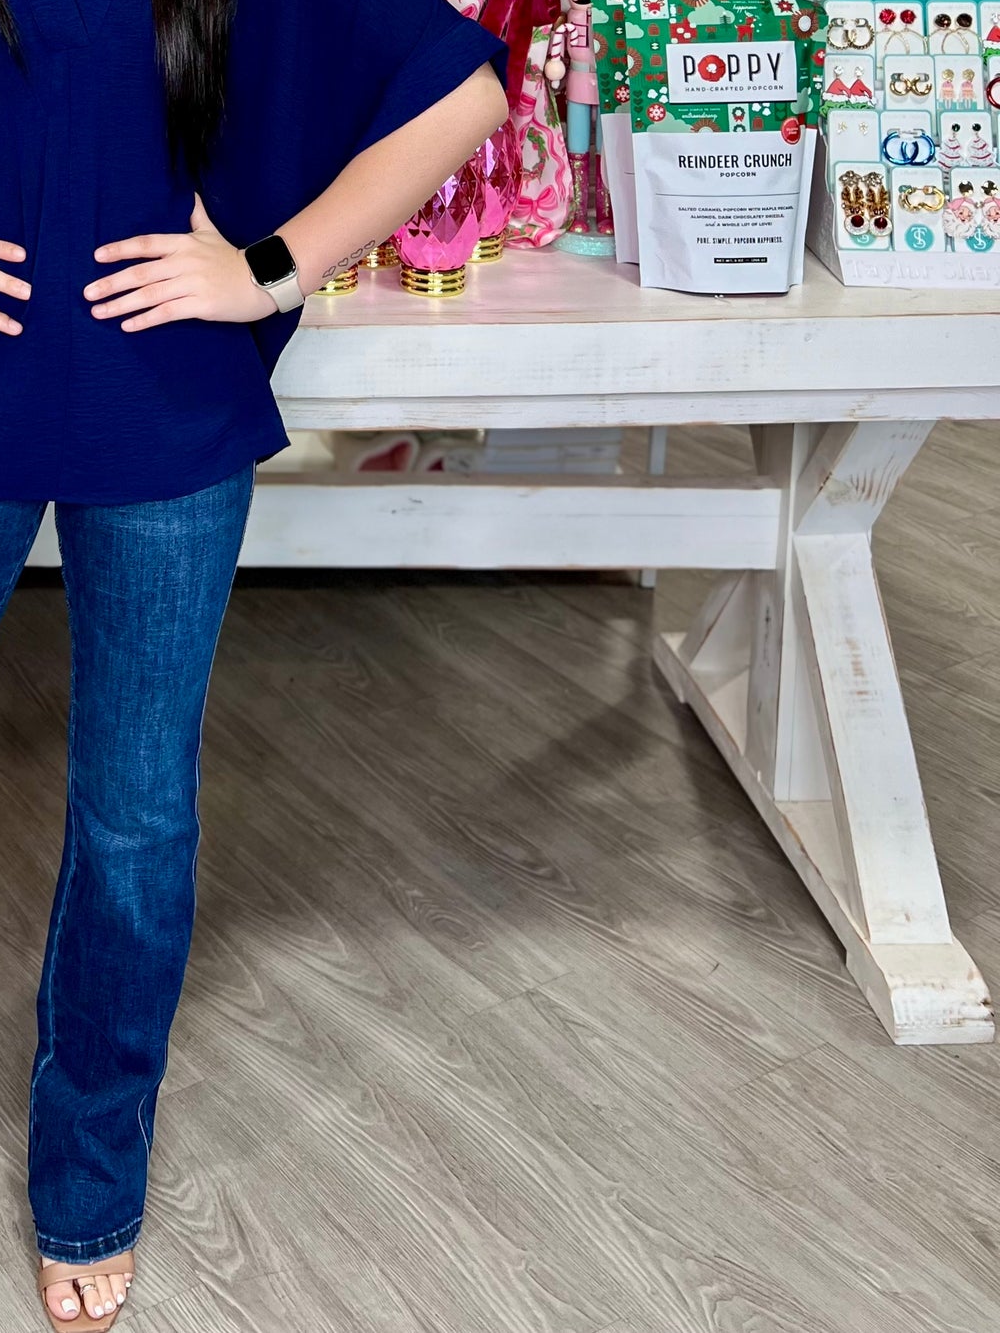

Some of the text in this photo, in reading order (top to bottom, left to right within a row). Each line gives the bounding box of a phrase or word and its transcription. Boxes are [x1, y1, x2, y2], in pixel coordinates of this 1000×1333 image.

[682, 52, 781, 83] POPPY
[678, 153, 792, 169] REINDEER CRUNCH
